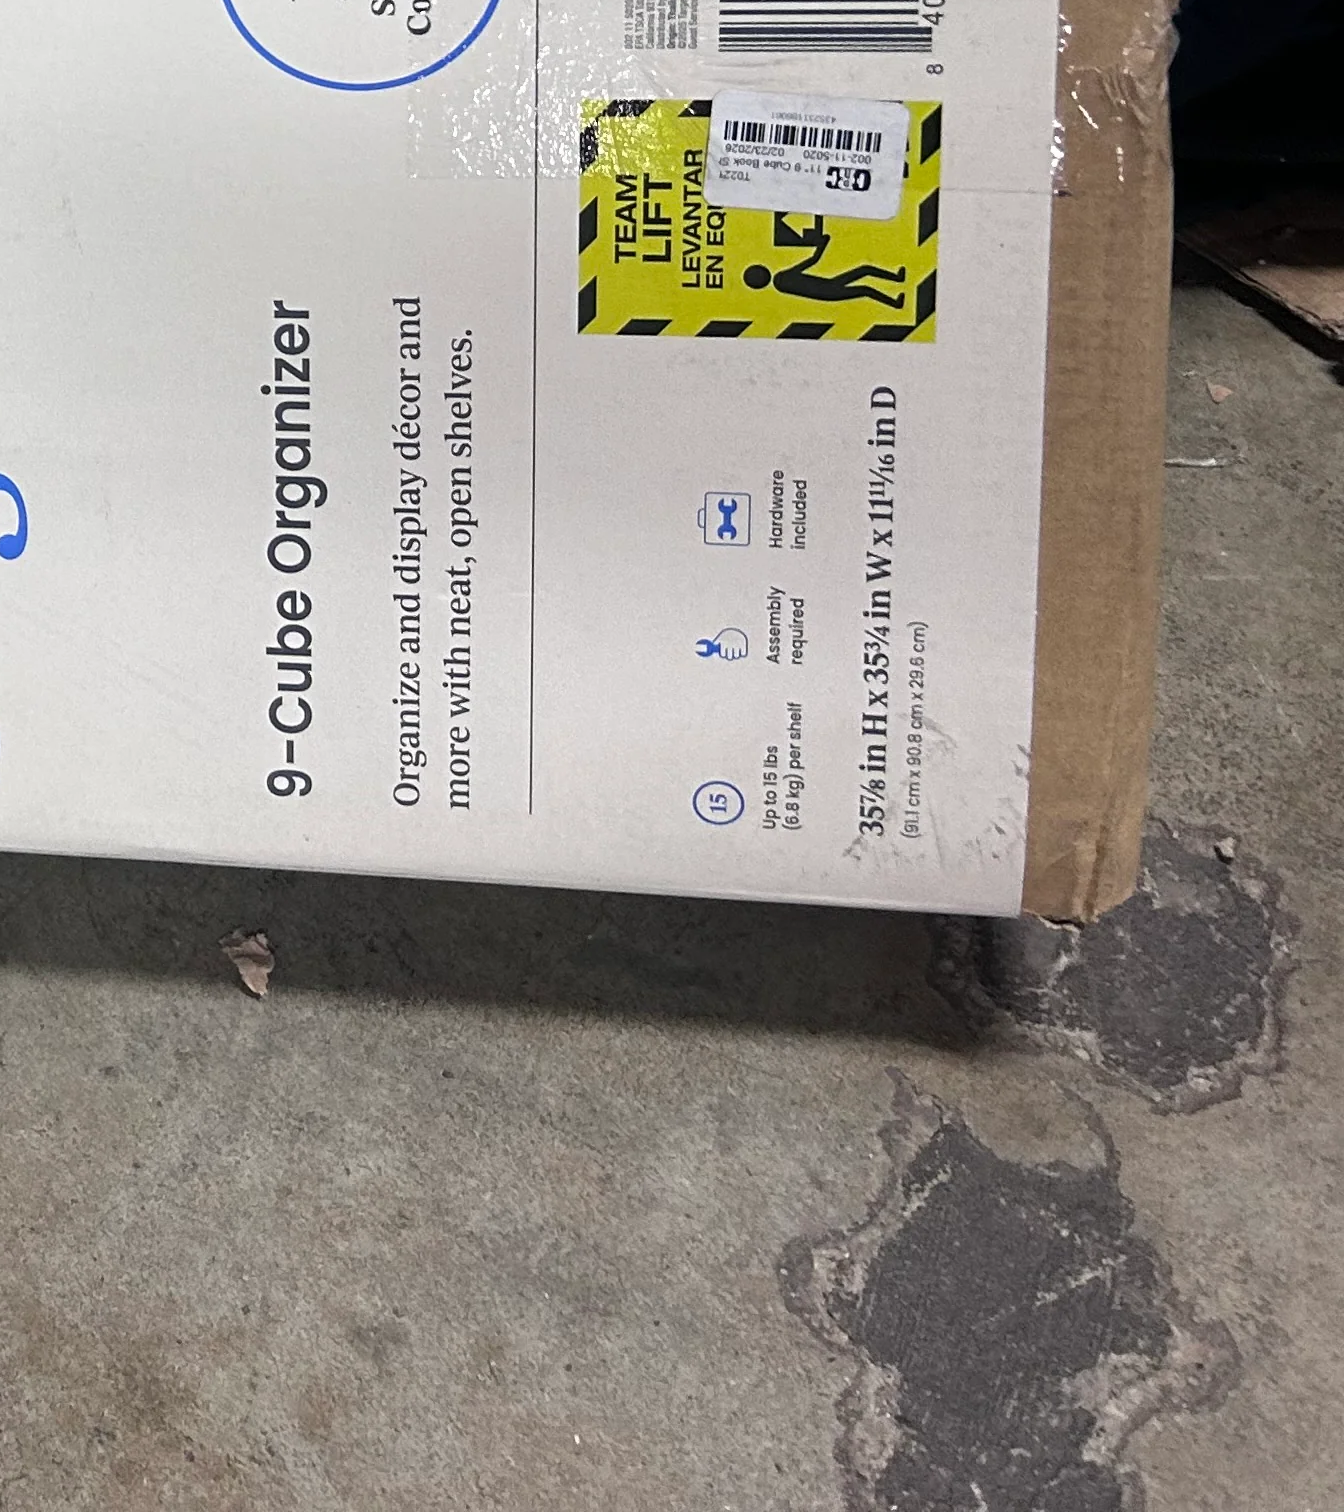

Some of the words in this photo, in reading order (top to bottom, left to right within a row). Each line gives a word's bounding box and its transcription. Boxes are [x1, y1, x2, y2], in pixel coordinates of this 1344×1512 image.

[925, 63, 944, 75] 8
[732, 157, 760, 169] Book
[762, 159, 791, 172] Cube
[802, 145, 871, 169] 002-11-5020
[611, 172, 639, 264] TEAM
[640, 171, 674, 263] LIFT
[681, 148, 703, 288] LEVANTAR
[705, 254, 724, 289] EN
[392, 296, 421, 360] and
[443, 328, 473, 457] shelves.
[870, 385, 896, 410] D
[391, 366, 421, 460] décor
[266, 299, 328, 573] Organizer
[867, 416, 896, 447] in
[450, 465, 479, 547] open
[768, 469, 784, 548] Hardware
[790, 478, 807, 549] included
[391, 467, 428, 584] display
[872, 528, 893, 547] x
[865, 550, 892, 582] W
[445, 556, 477, 636] neat,
[862, 589, 891, 619] in
[392, 592, 421, 653] and
[765, 585, 786, 664] Assembly
[788, 597, 808, 665] required
[906, 620, 929, 652] cm)
[441, 645, 471, 717] with
[907, 655, 925, 688] 29.6
[265, 589, 313, 796] 9-Cube
[868, 689, 888, 708] x
[786, 701, 802, 740] shelf
[861, 711, 888, 737] H
[910, 703, 923, 729] cm
[392, 661, 427, 806] Organize
[905, 733, 923, 766] 90.8
[449, 725, 471, 809] more
[763, 745, 778, 768] lbs
[789, 742, 805, 770] per
[858, 743, 887, 773] in
[762, 771, 778, 786] 15
[782, 773, 805, 798] kg)
[908, 780, 921, 807] cm
[709, 793, 727, 812] 15
[763, 789, 777, 805] to
[762, 808, 781, 829] Up
[781, 801, 803, 830] (6.8
